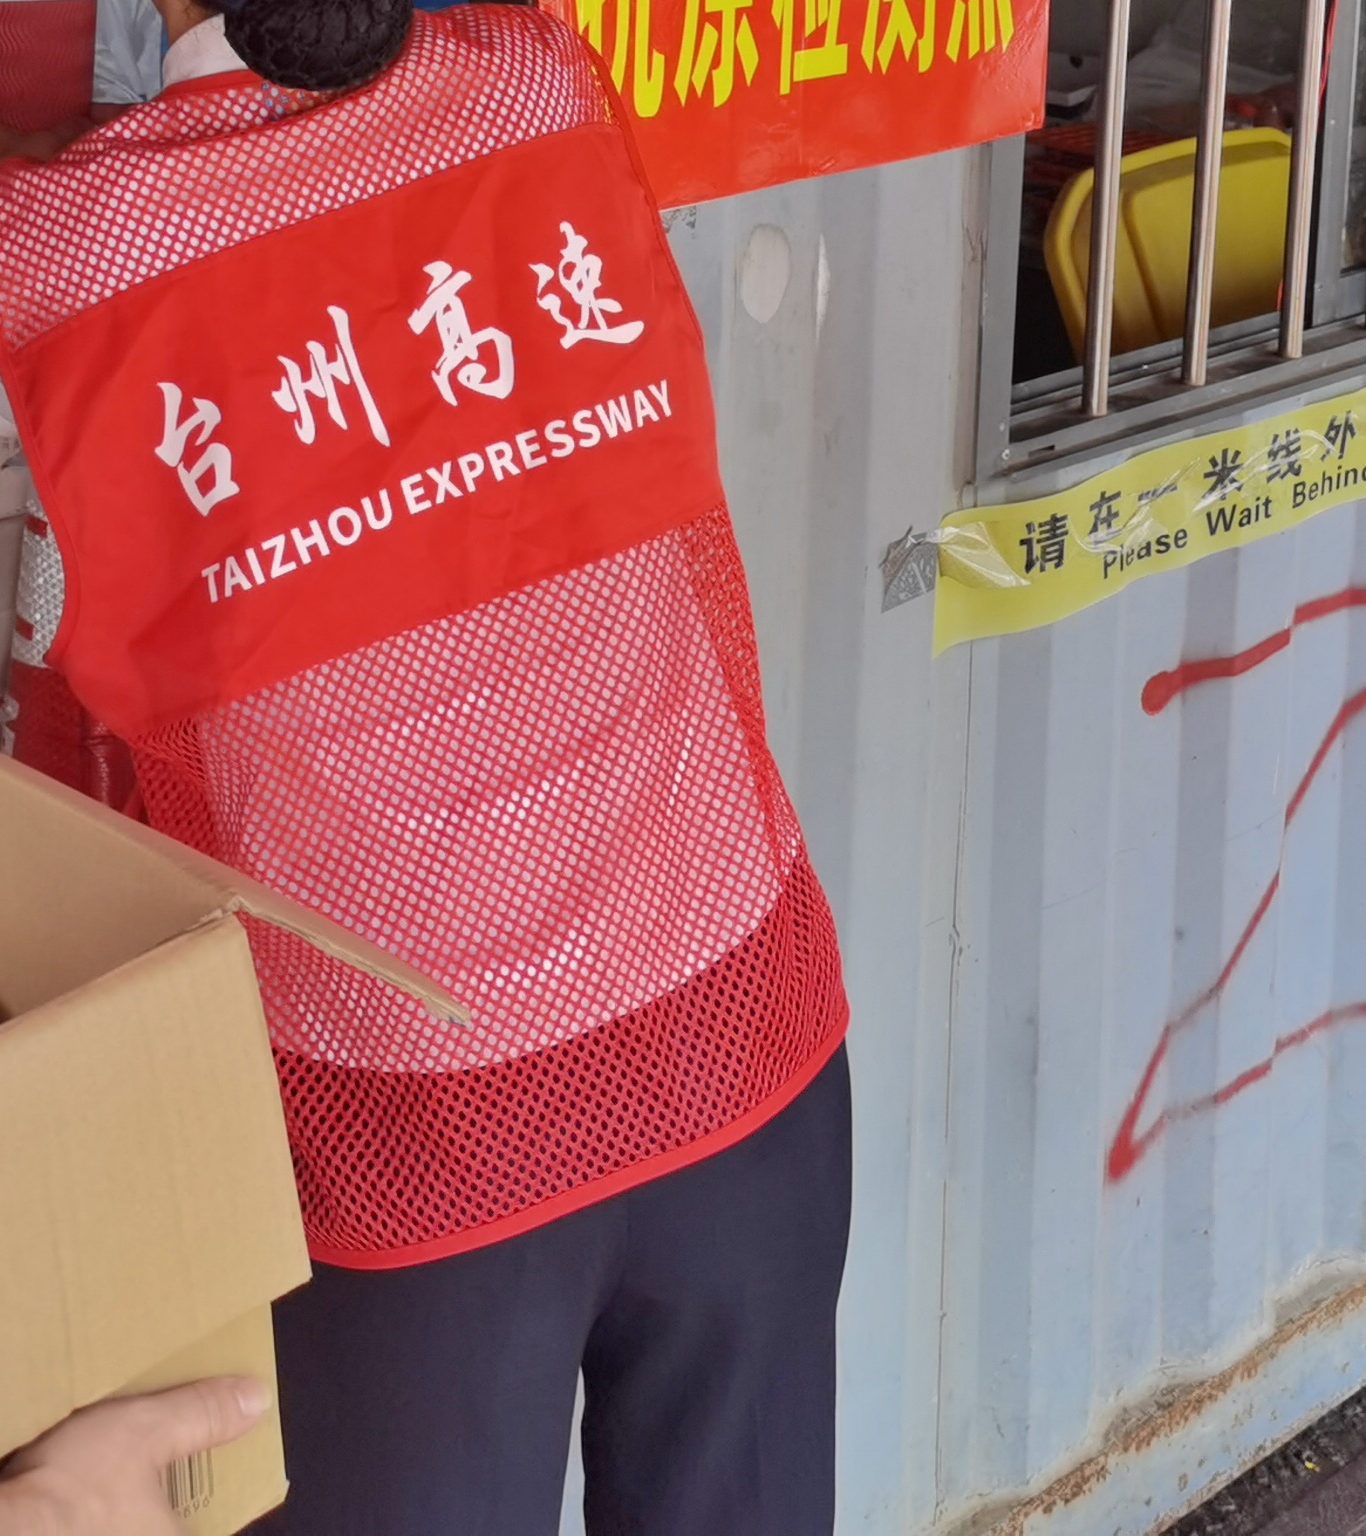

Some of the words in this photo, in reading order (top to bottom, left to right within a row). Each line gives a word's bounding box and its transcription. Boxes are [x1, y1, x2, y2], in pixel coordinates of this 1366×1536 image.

[154, 220, 645, 515] 台州高速
[200, 488, 394, 604] TAIZHOU
[406, 379, 674, 516] EXPRESSWAY
[1102, 527, 1188, 579] Please
[1205, 495, 1272, 537] Wait
